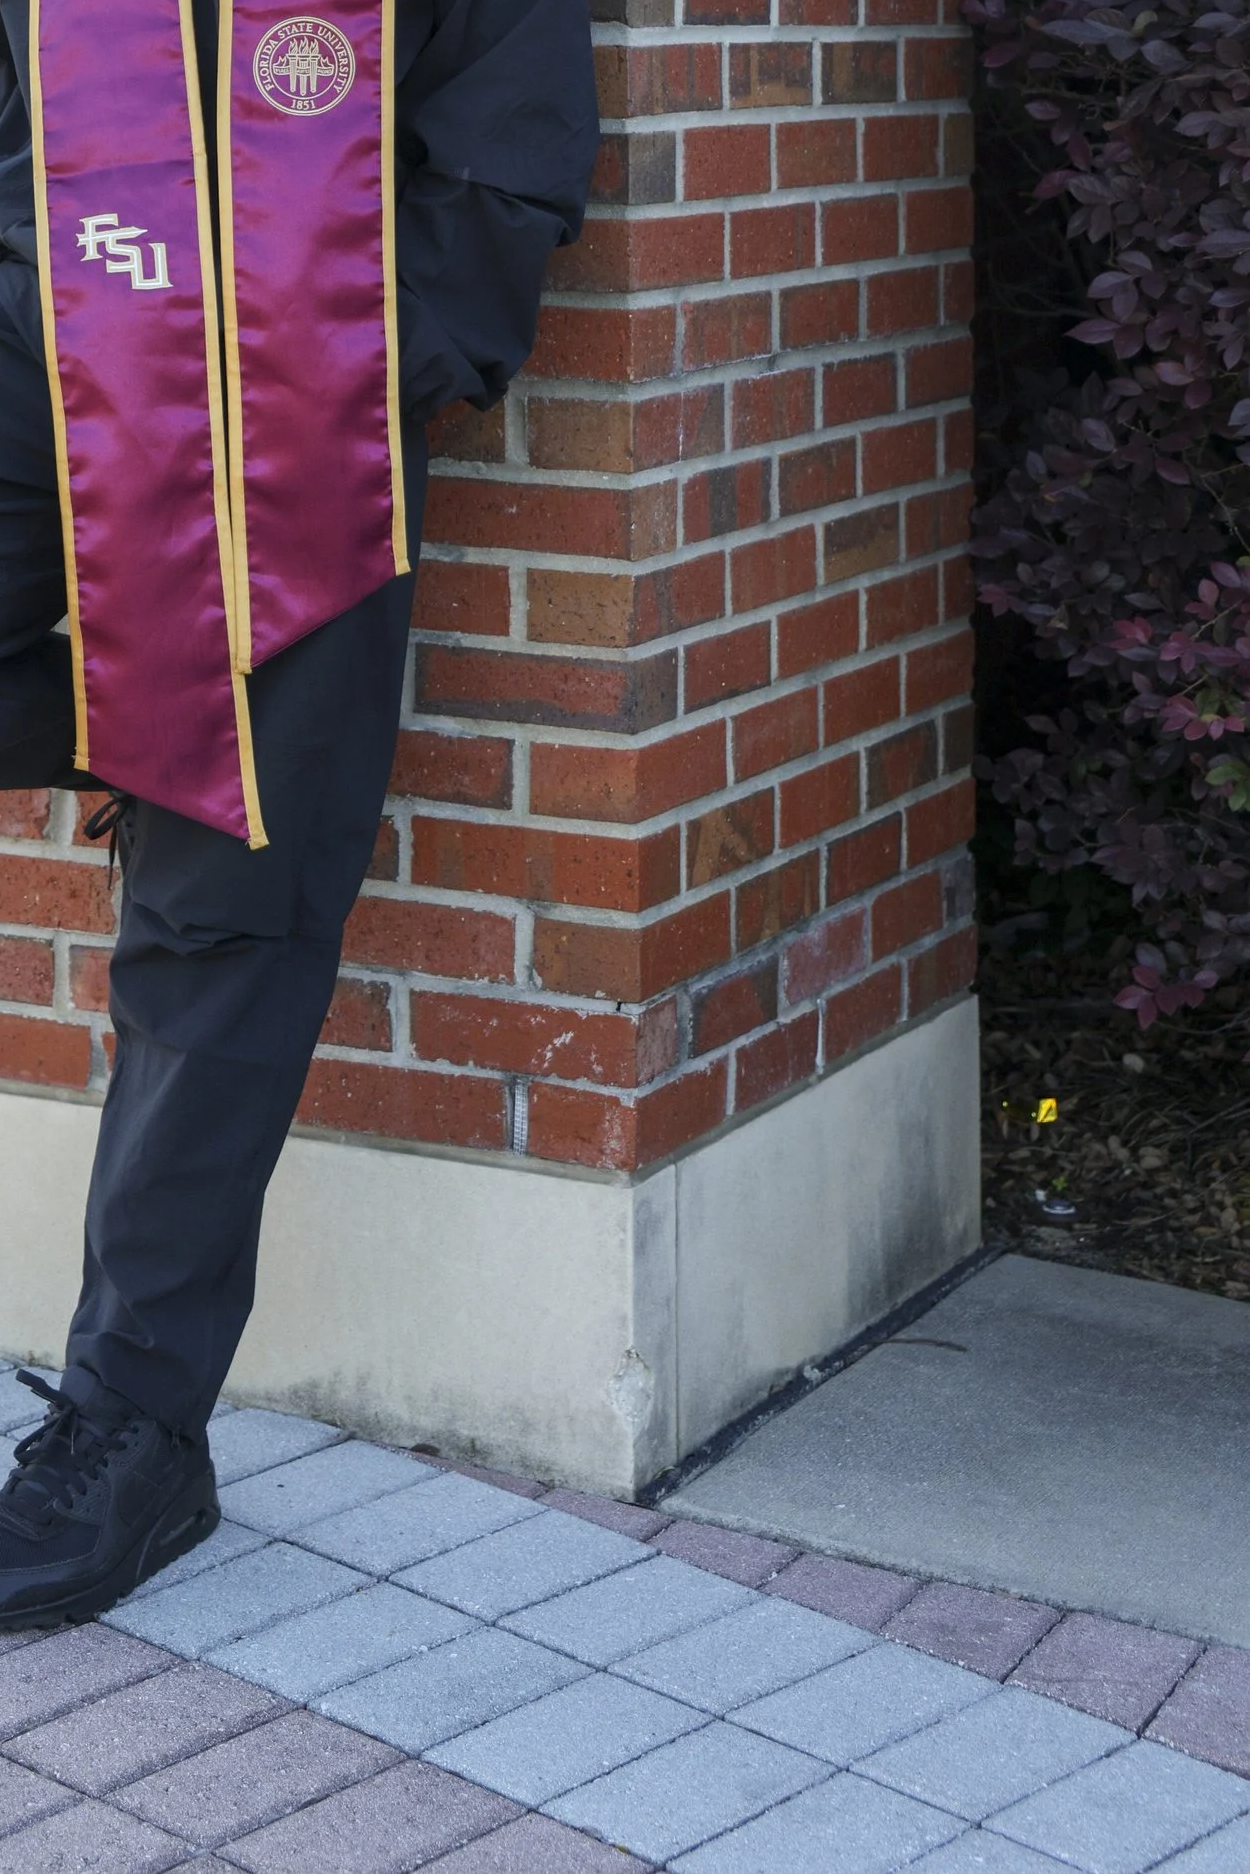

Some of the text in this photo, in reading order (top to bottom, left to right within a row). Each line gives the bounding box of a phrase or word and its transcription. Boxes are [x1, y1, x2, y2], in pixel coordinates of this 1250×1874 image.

[259, 22, 350, 94] FLORIDA STATE UNIVERSITY
[290, 99, 317, 111] 1851
[76, 213, 174, 291] FSU
